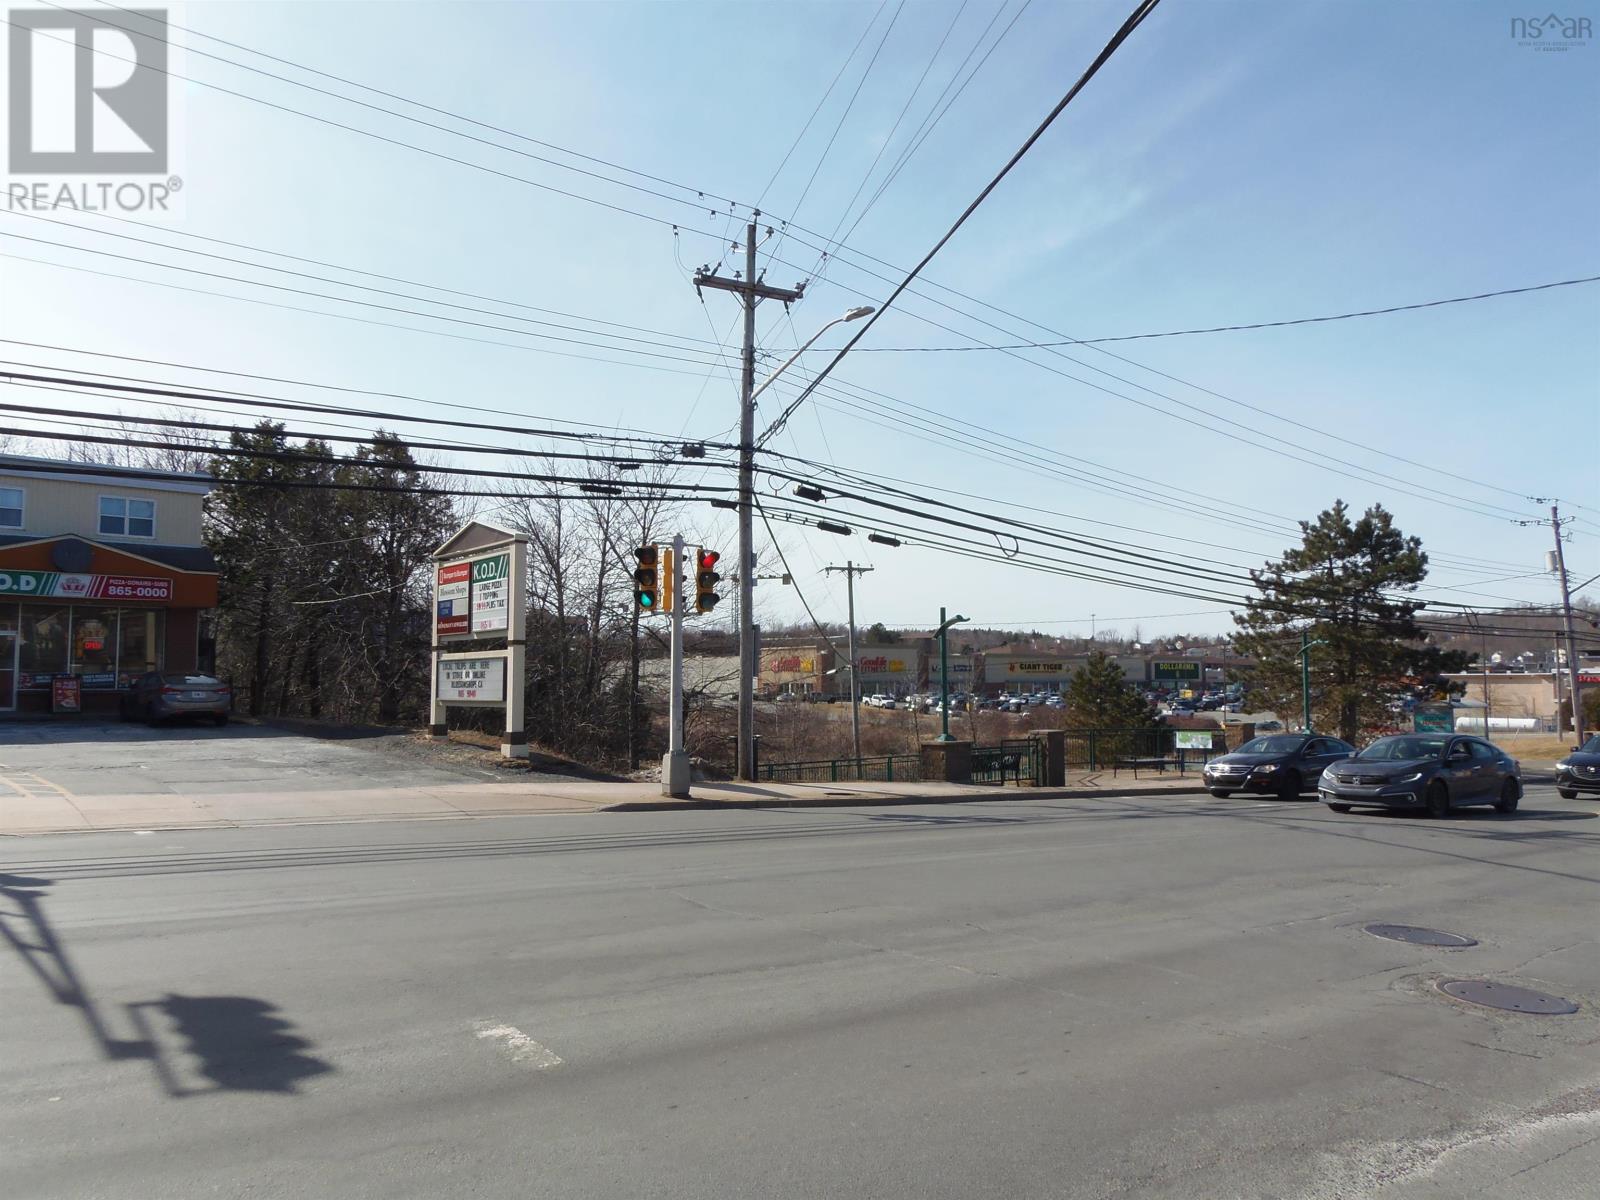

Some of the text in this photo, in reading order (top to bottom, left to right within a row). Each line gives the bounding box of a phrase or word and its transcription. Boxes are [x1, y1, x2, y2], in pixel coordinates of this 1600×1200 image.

[108, 586, 168, 597] 865-0000
[1019, 663, 1063, 671] GIANT TIGER
